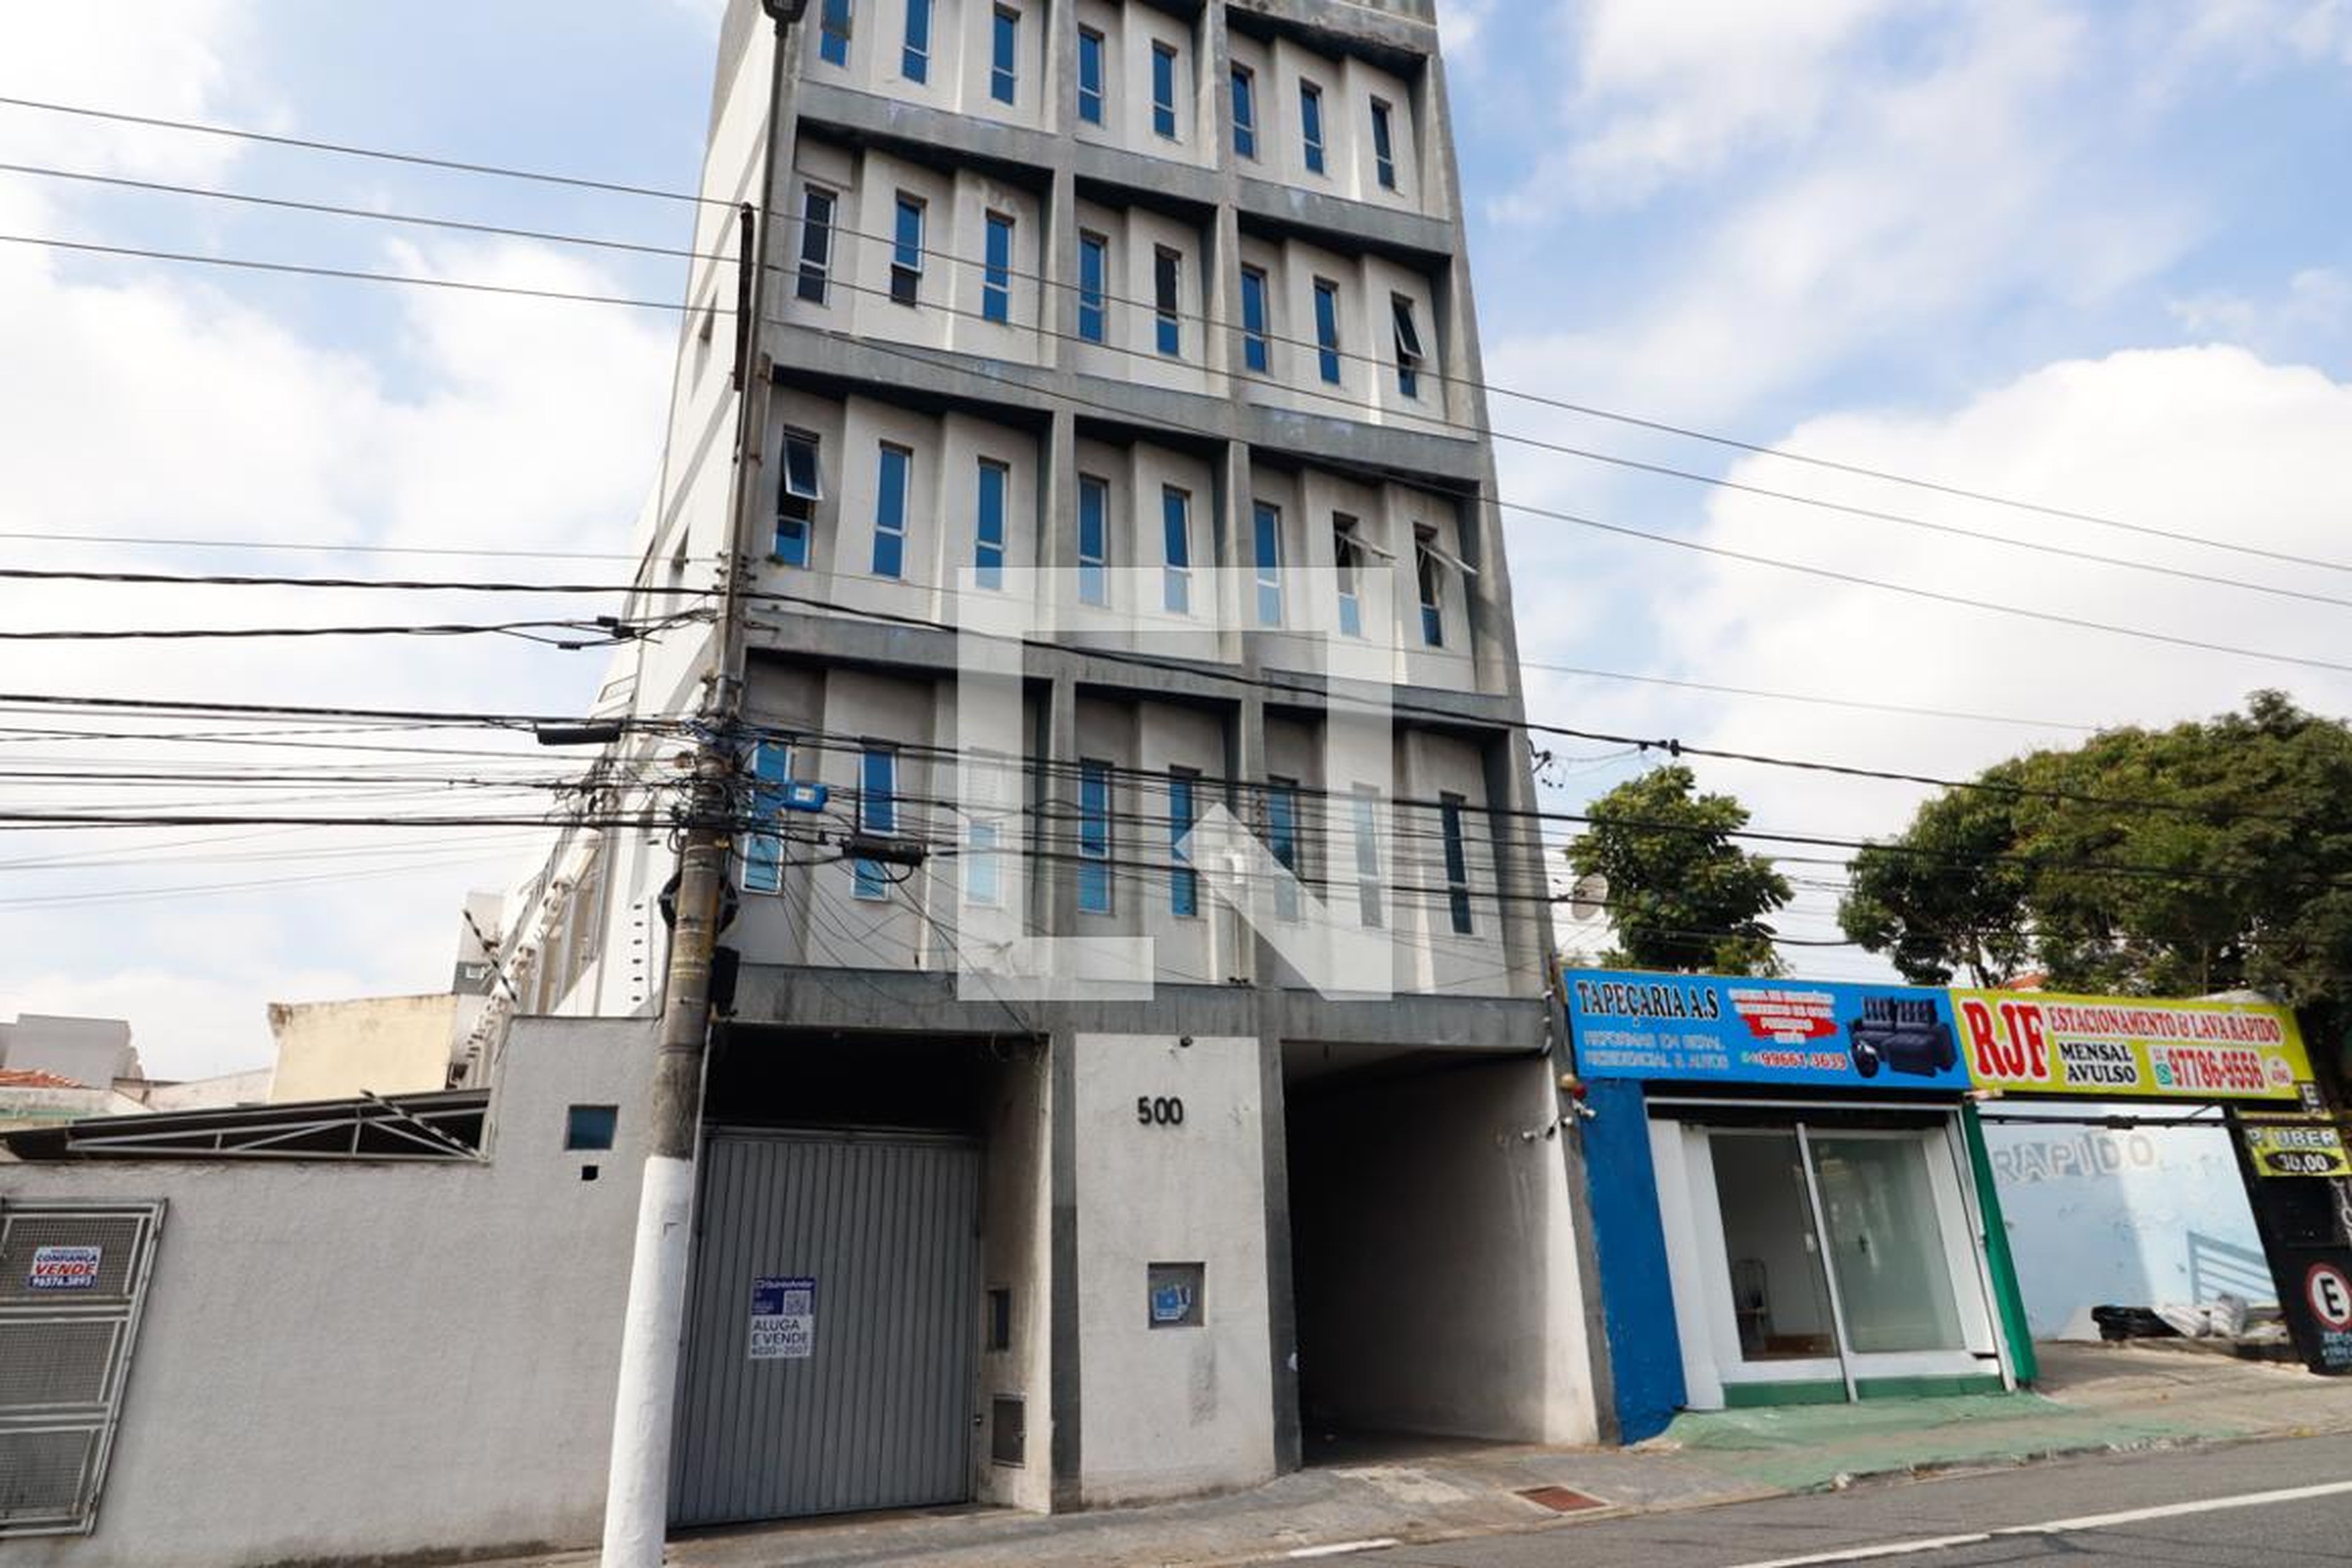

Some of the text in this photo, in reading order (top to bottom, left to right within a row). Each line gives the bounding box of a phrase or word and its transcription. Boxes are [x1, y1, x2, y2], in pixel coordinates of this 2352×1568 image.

[1577, 982, 1686, 1027] TAPEÇARIA
[2048, 1007, 2176, 1037] ESTACIONAMENTO
[2189, 1014, 2229, 1040] LAVA
[1962, 1002, 2047, 1077] RJF
[2059, 1043, 2132, 1061] MENSAL
[2067, 1065, 2137, 1083] AVULSO
[1137, 1096, 1184, 1125] 500
[2274, 1129, 2339, 1147] UBER
[36, 1263, 96, 1275] VENDE
[2320, 1278, 2344, 1317] E
[753, 1319, 800, 1331] ALUGA
